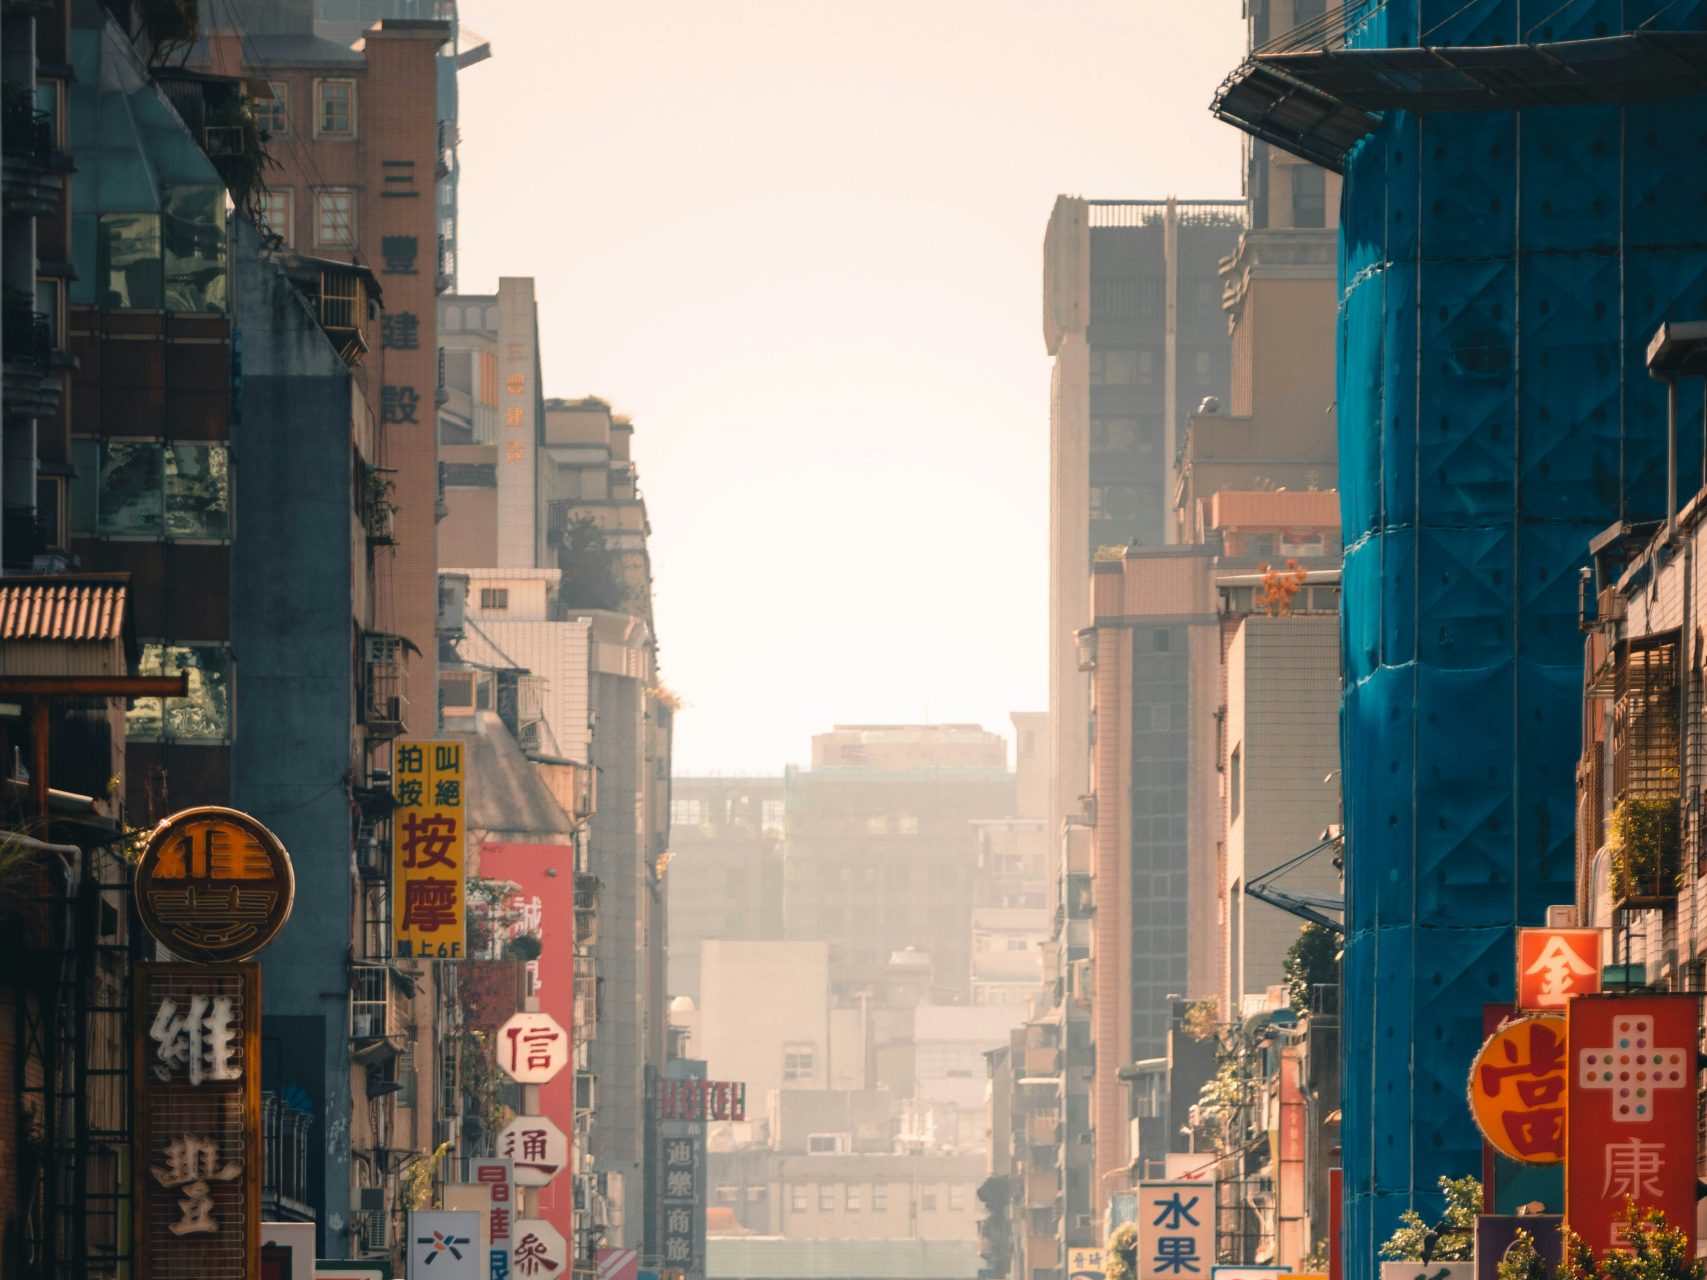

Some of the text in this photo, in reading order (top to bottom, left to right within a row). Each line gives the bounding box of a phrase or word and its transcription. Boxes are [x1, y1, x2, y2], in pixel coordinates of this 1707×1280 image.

[380, 160, 419, 424] 三豐建設
[398, 744, 423, 807] 拍按
[435, 744, 460, 806] 叫絕
[401, 813, 457, 932] 按摩
[1526, 936, 1596, 1005] 金
[663, 1081, 743, 1120] HOTEL
[1153, 1192, 1200, 1274] 水果
